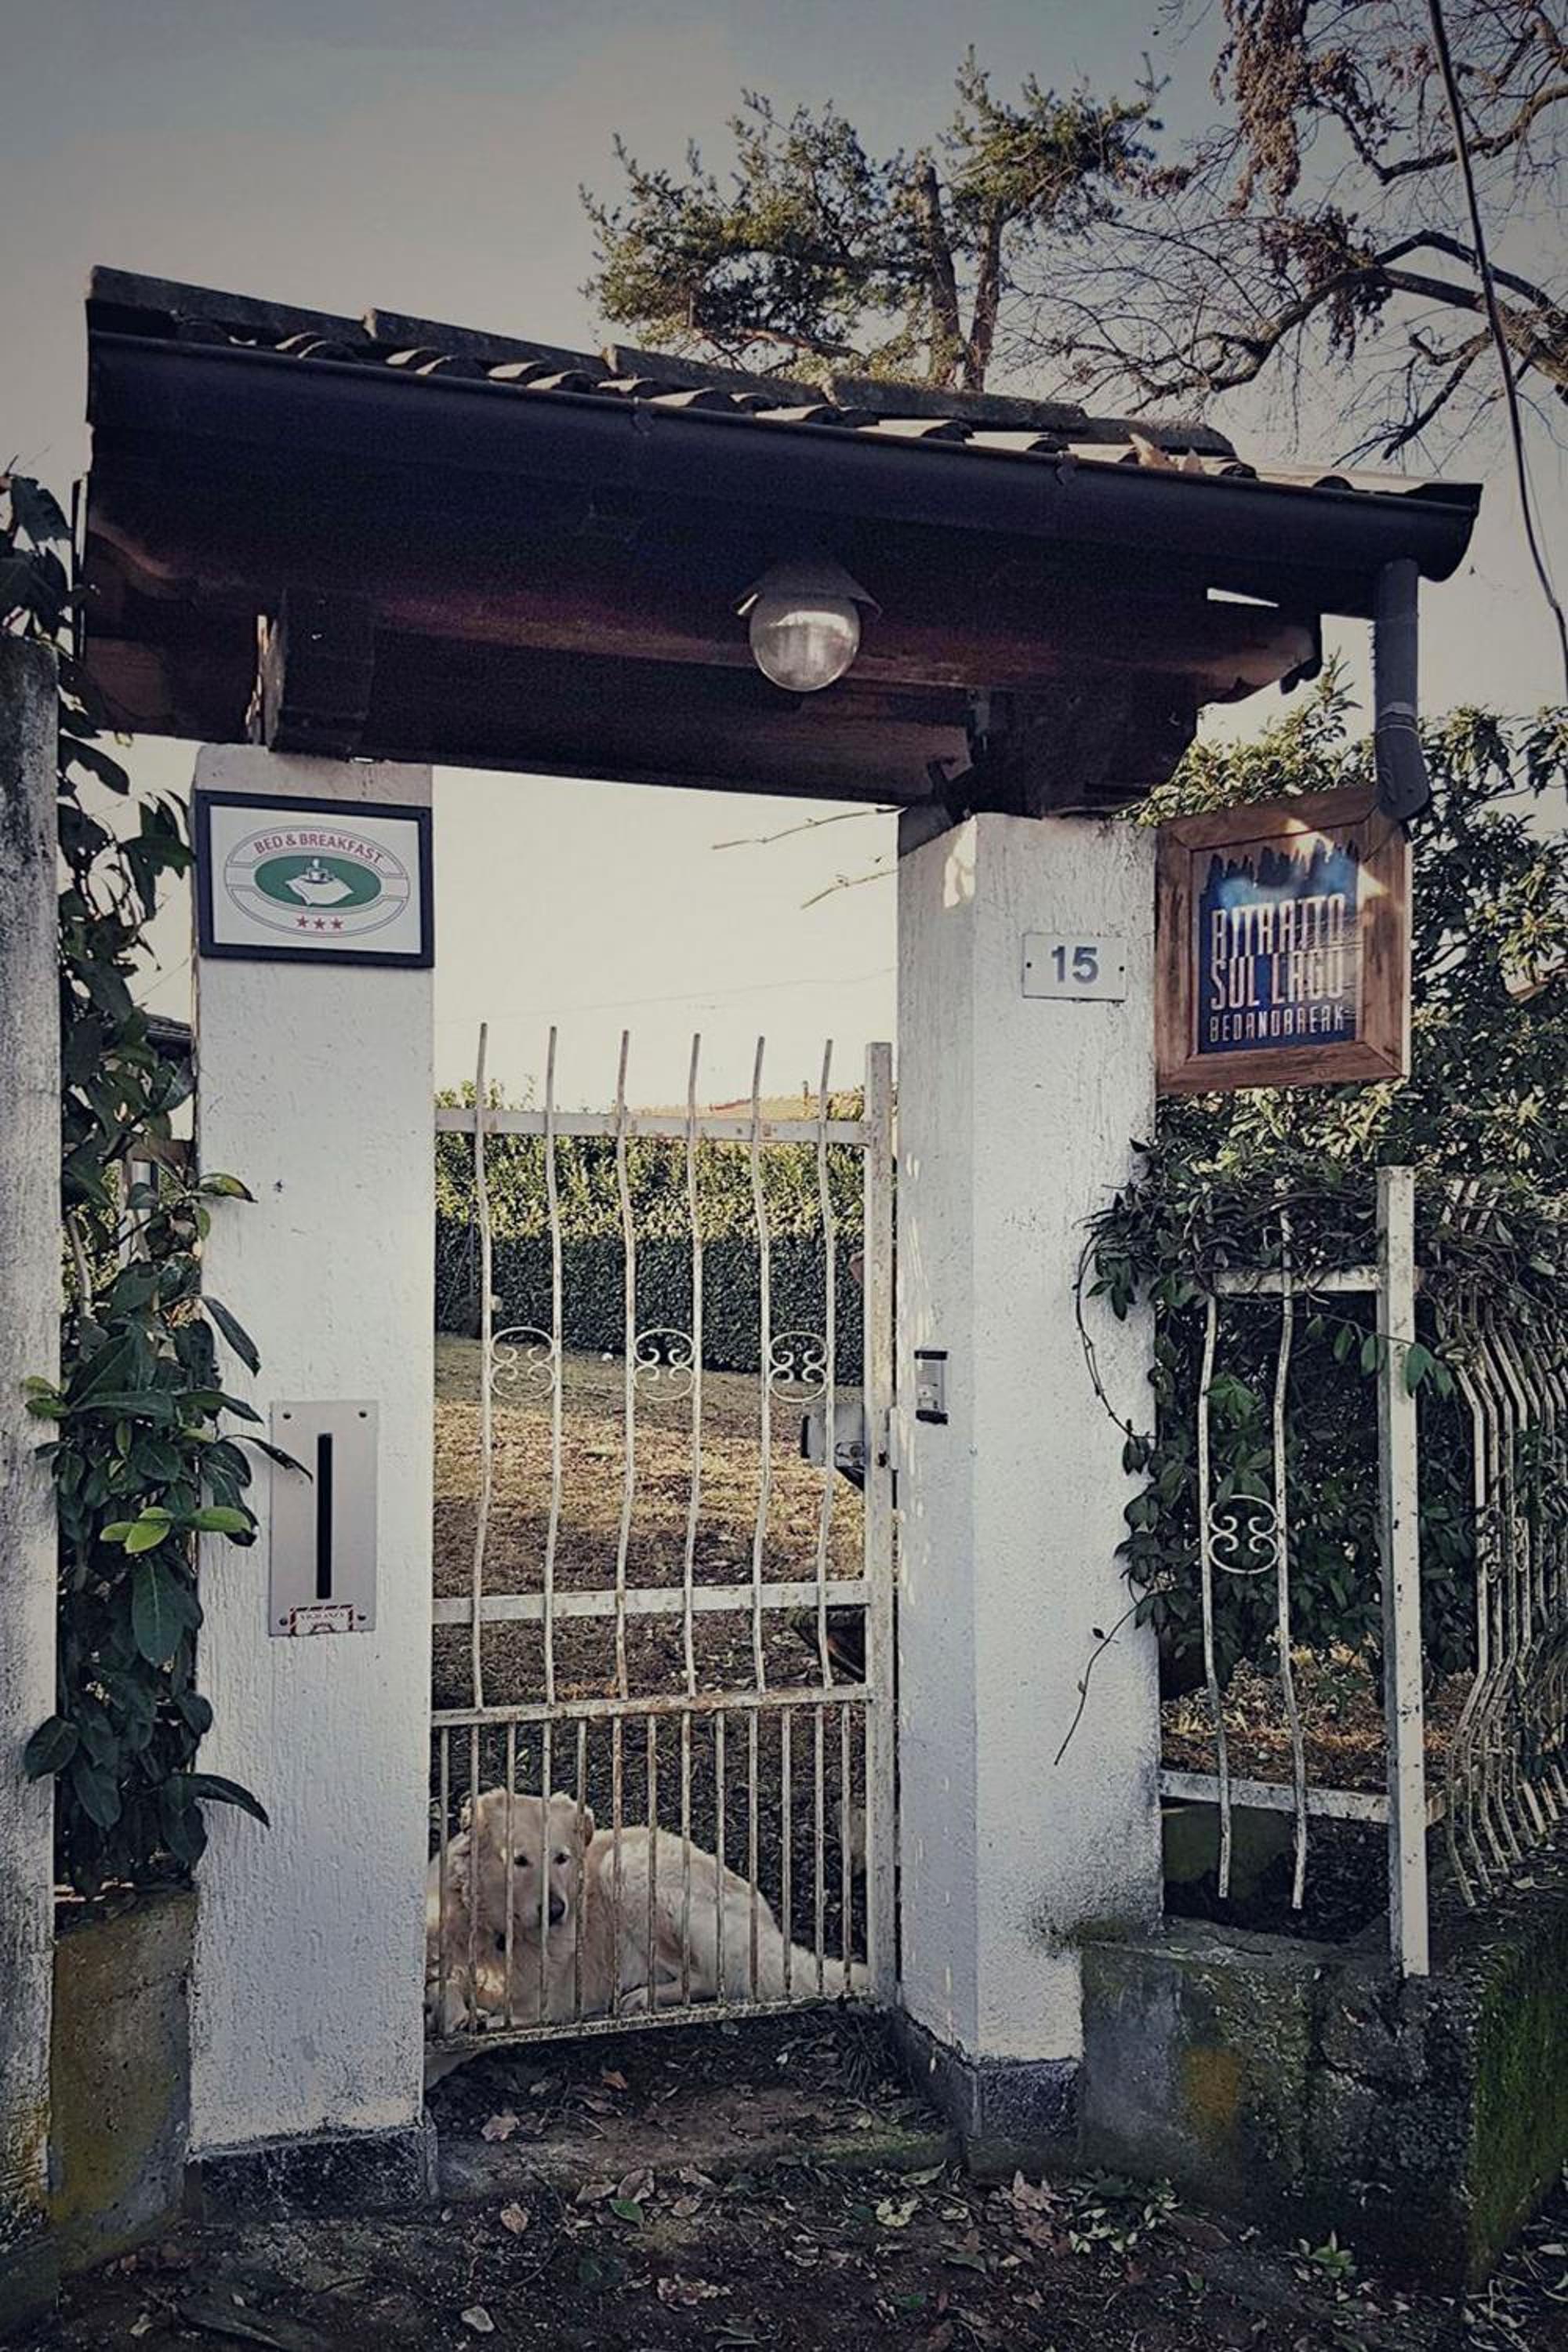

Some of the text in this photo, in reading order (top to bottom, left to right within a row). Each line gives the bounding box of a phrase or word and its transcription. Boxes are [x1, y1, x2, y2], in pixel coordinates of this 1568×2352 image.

[254, 833, 383, 863] BED & BREAKFAST
[1051, 946, 1098, 983] 15
[1210, 950, 1343, 1011] SUL LAGO
